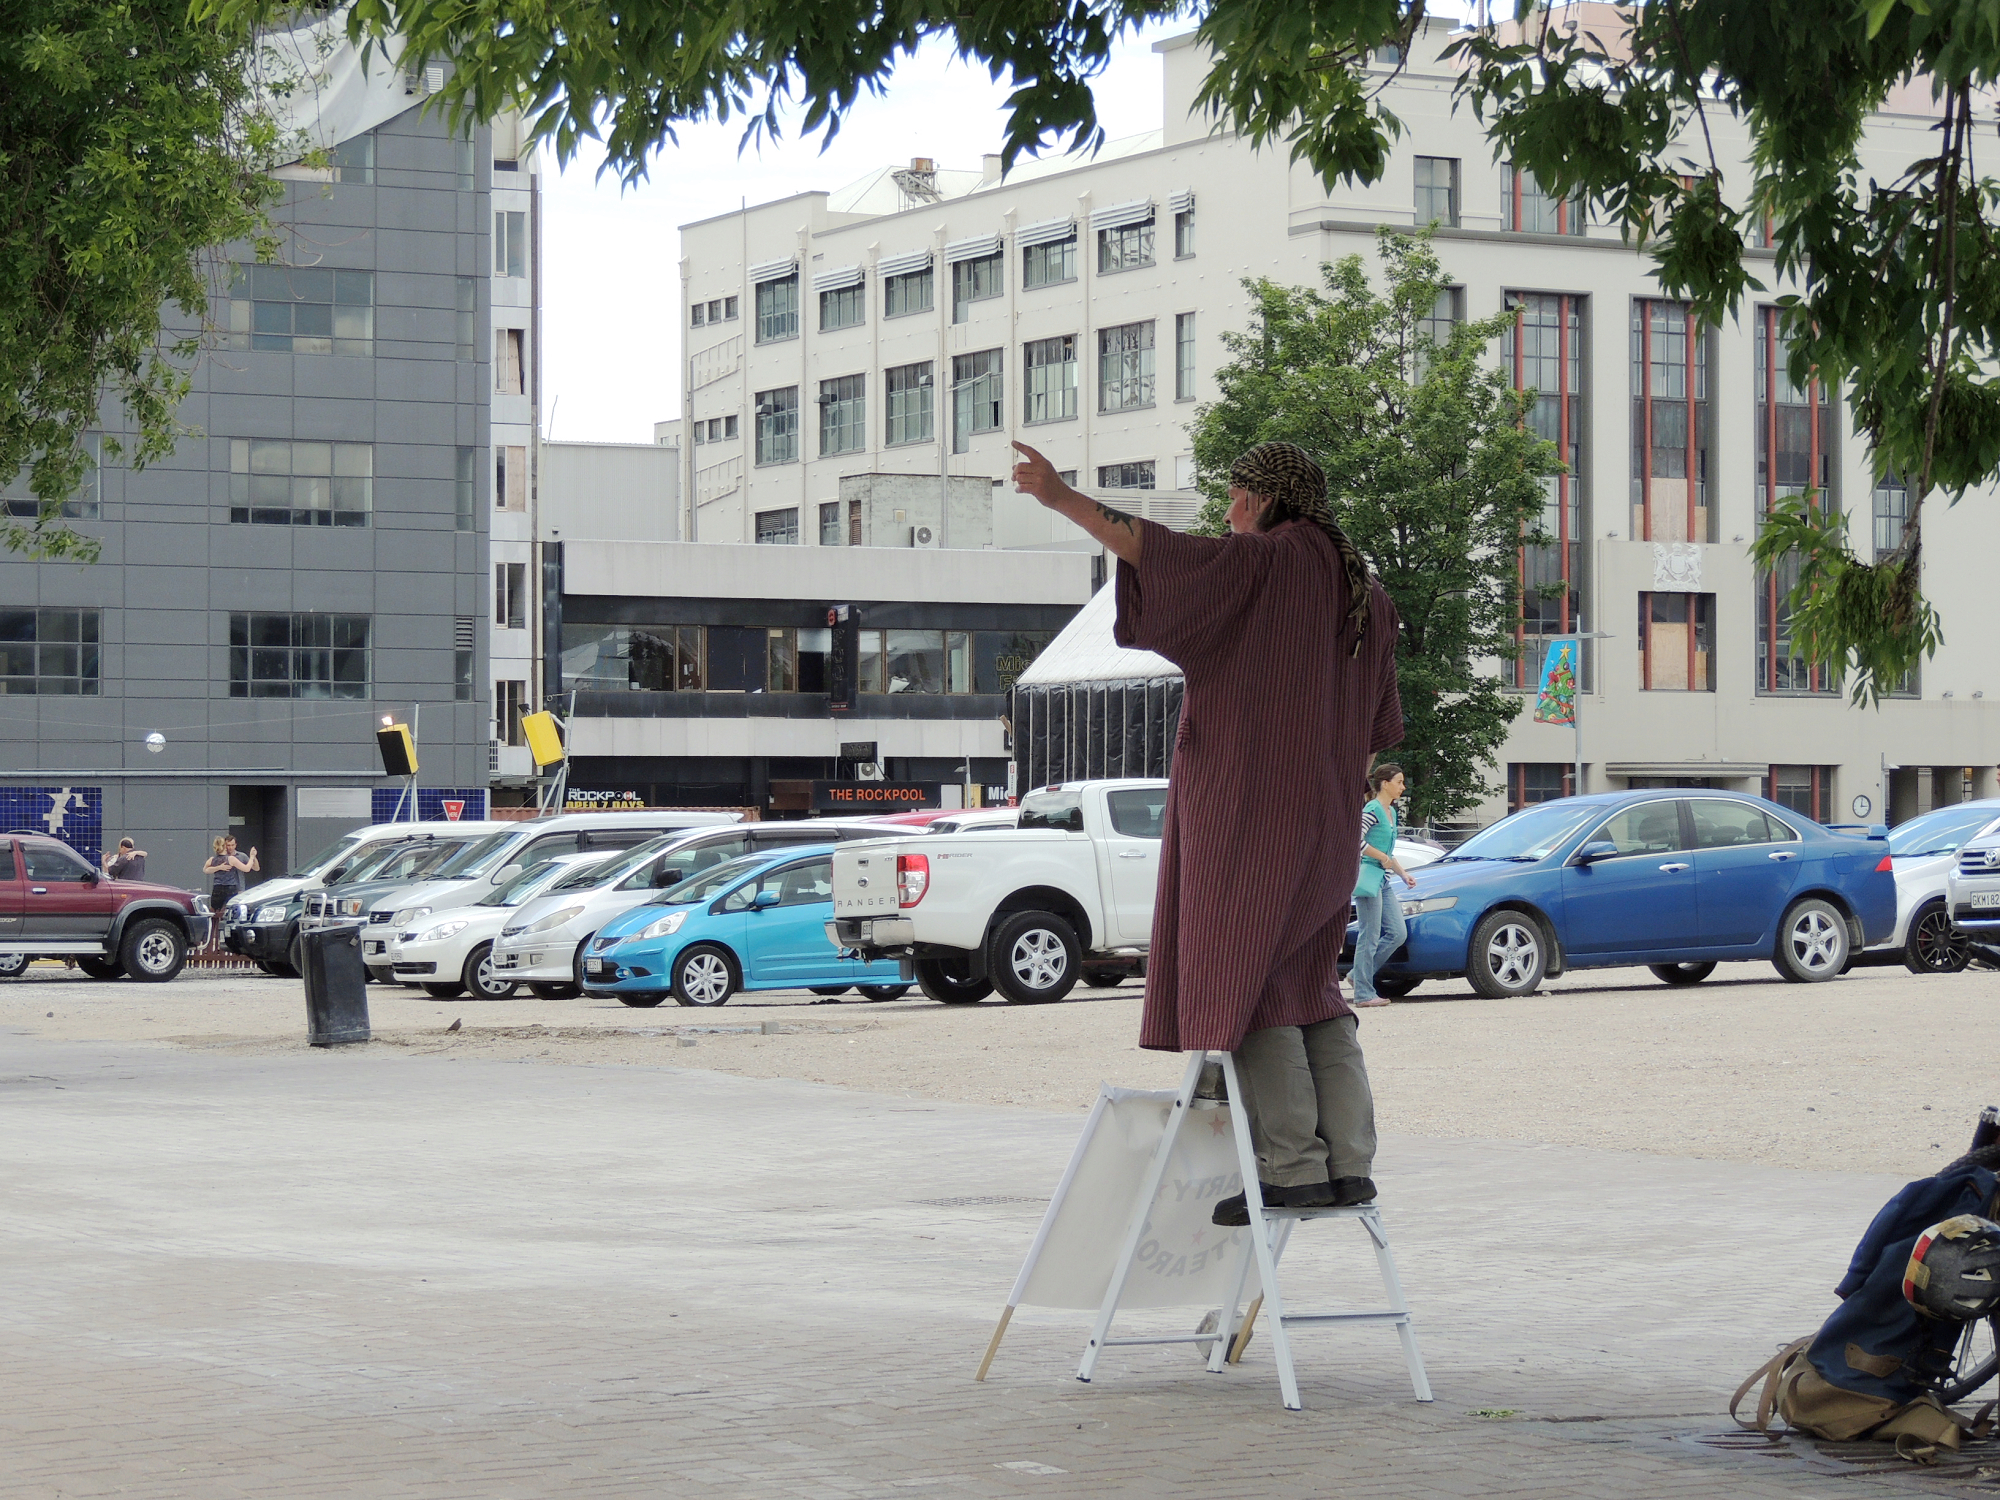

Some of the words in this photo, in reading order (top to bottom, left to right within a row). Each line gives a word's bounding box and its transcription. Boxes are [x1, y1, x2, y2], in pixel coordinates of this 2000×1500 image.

[568, 791, 642, 801] ROCKPOOL
[828, 788, 853, 801] THE
[856, 788, 926, 801] ROCKPOOL
[565, 800, 598, 808] OPEN
[602, 800, 609, 808] 7
[612, 800, 645, 808] DAYS
[837, 896, 896, 908] RANGER
[1972, 894, 2000, 906] GKM182
